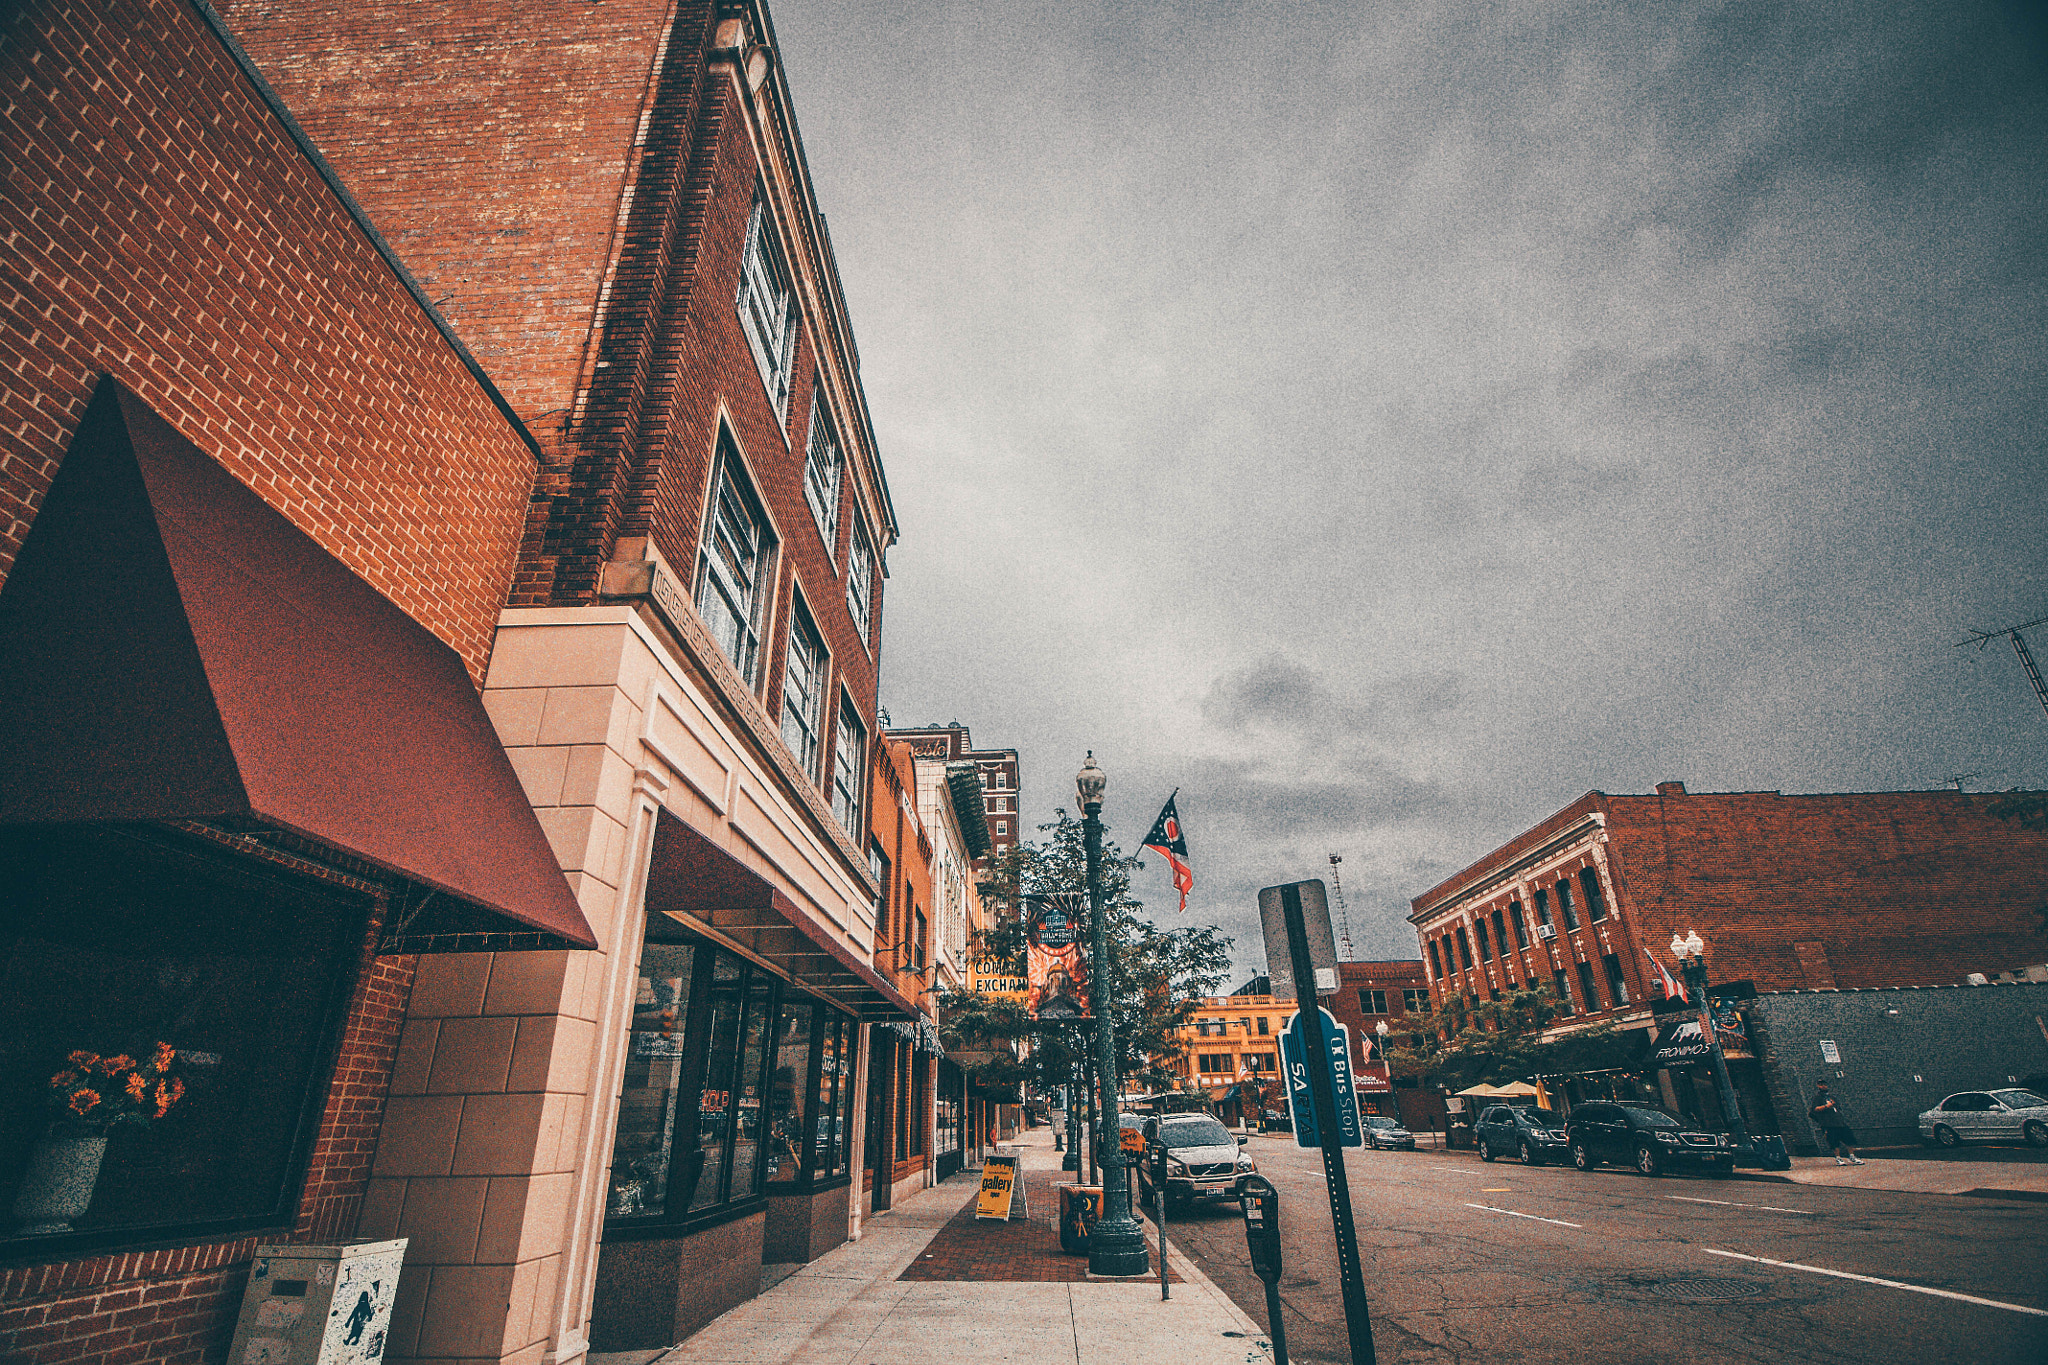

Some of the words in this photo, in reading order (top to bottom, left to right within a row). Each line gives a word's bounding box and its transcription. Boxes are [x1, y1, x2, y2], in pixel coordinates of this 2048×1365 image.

[976, 979, 1028, 991] EXCHAN
[1291, 1062, 1314, 1135] SARTA
[1333, 1060, 1347, 1094] Bus
[1340, 1097, 1355, 1137] Stop
[982, 1176, 1012, 1193] gallery
